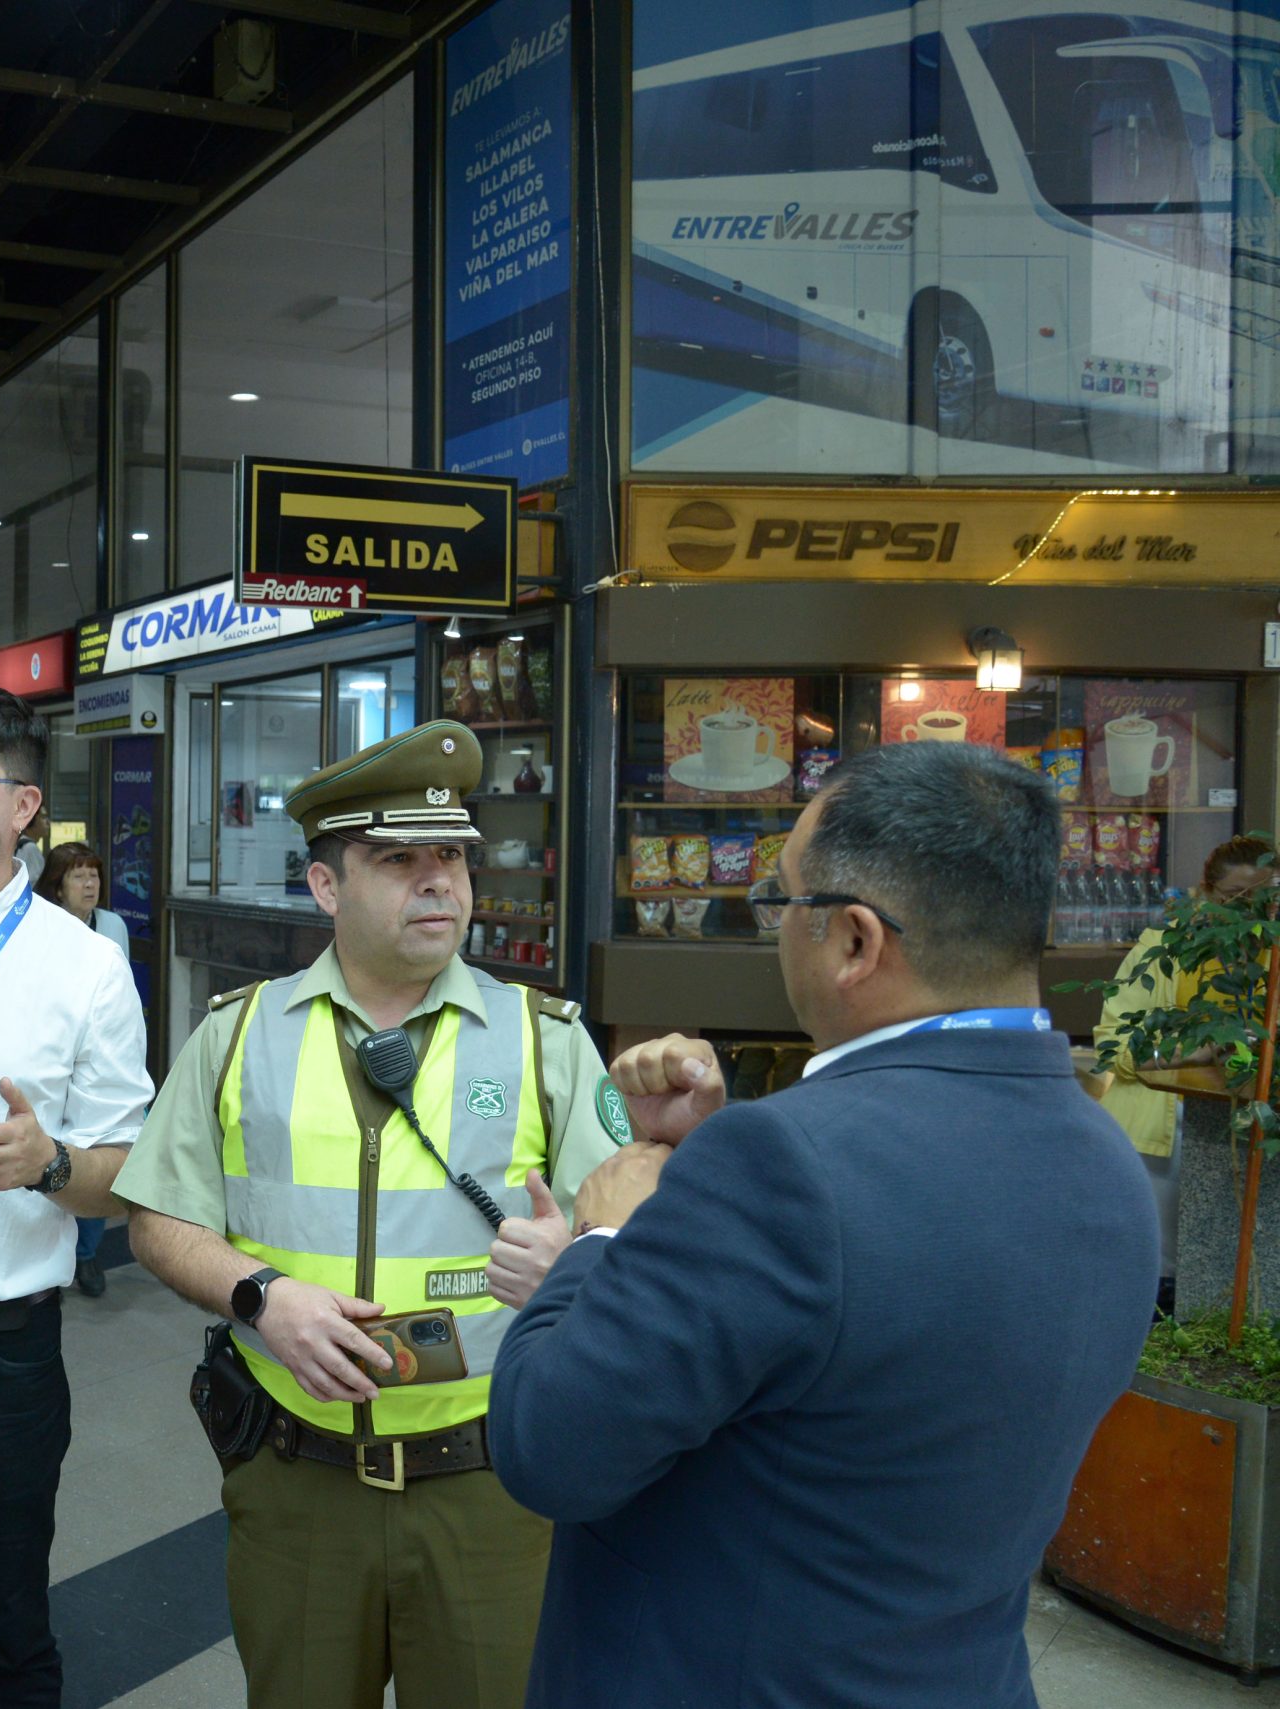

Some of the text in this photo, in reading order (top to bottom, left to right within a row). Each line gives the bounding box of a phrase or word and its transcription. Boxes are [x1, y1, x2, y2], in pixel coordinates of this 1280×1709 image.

[486, 111, 531, 148] LLEVAMOS
[465, 119, 553, 183] SALAMANCA
[480, 154, 536, 198] ILLAPEL
[472, 173, 545, 226] LOS VILOS
[472, 197, 550, 250] LA CALERA
[672, 203, 920, 241] ENTREVALLES
[465, 220, 552, 277] VALPARAISO
[458, 241, 559, 303] VIÑA DEL MAR
[468, 321, 554, 372] ATENDEMOS AQUÍ
[471, 366, 542, 404] SEGUNDO PISO
[474, 362, 512, 386] OFICINA
[305, 533, 460, 573] SALIDA
[746, 518, 961, 564] PEPSI
[1082, 534, 1128, 562] del
[1135, 534, 1199, 563] Mar
[262, 578, 342, 604] Redbanc
[223, 623, 277, 642] SALON CAMA
[78, 689, 130, 713] ENCOMIENDAS
[666, 682, 712, 707] Latte
[113, 770, 152, 784] CORMAR
